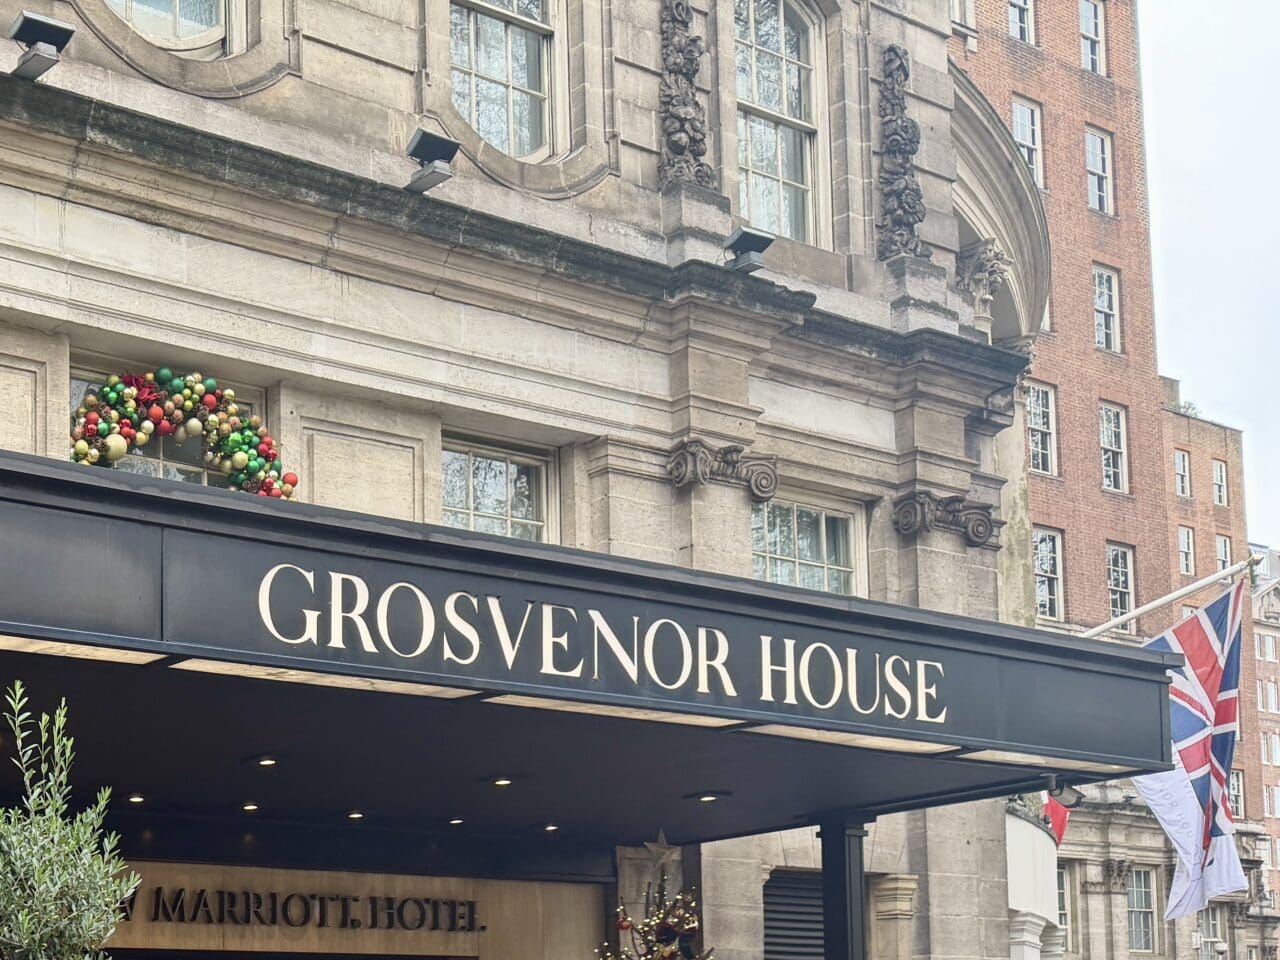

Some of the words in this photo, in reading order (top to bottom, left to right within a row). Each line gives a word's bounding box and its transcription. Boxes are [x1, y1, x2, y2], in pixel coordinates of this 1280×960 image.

[258, 562, 738, 698] GROSVENOR
[760, 634, 950, 724] HOUSE
[151, 886, 361, 929] MARRIOTT
[368, 896, 488, 932] HOTEL
